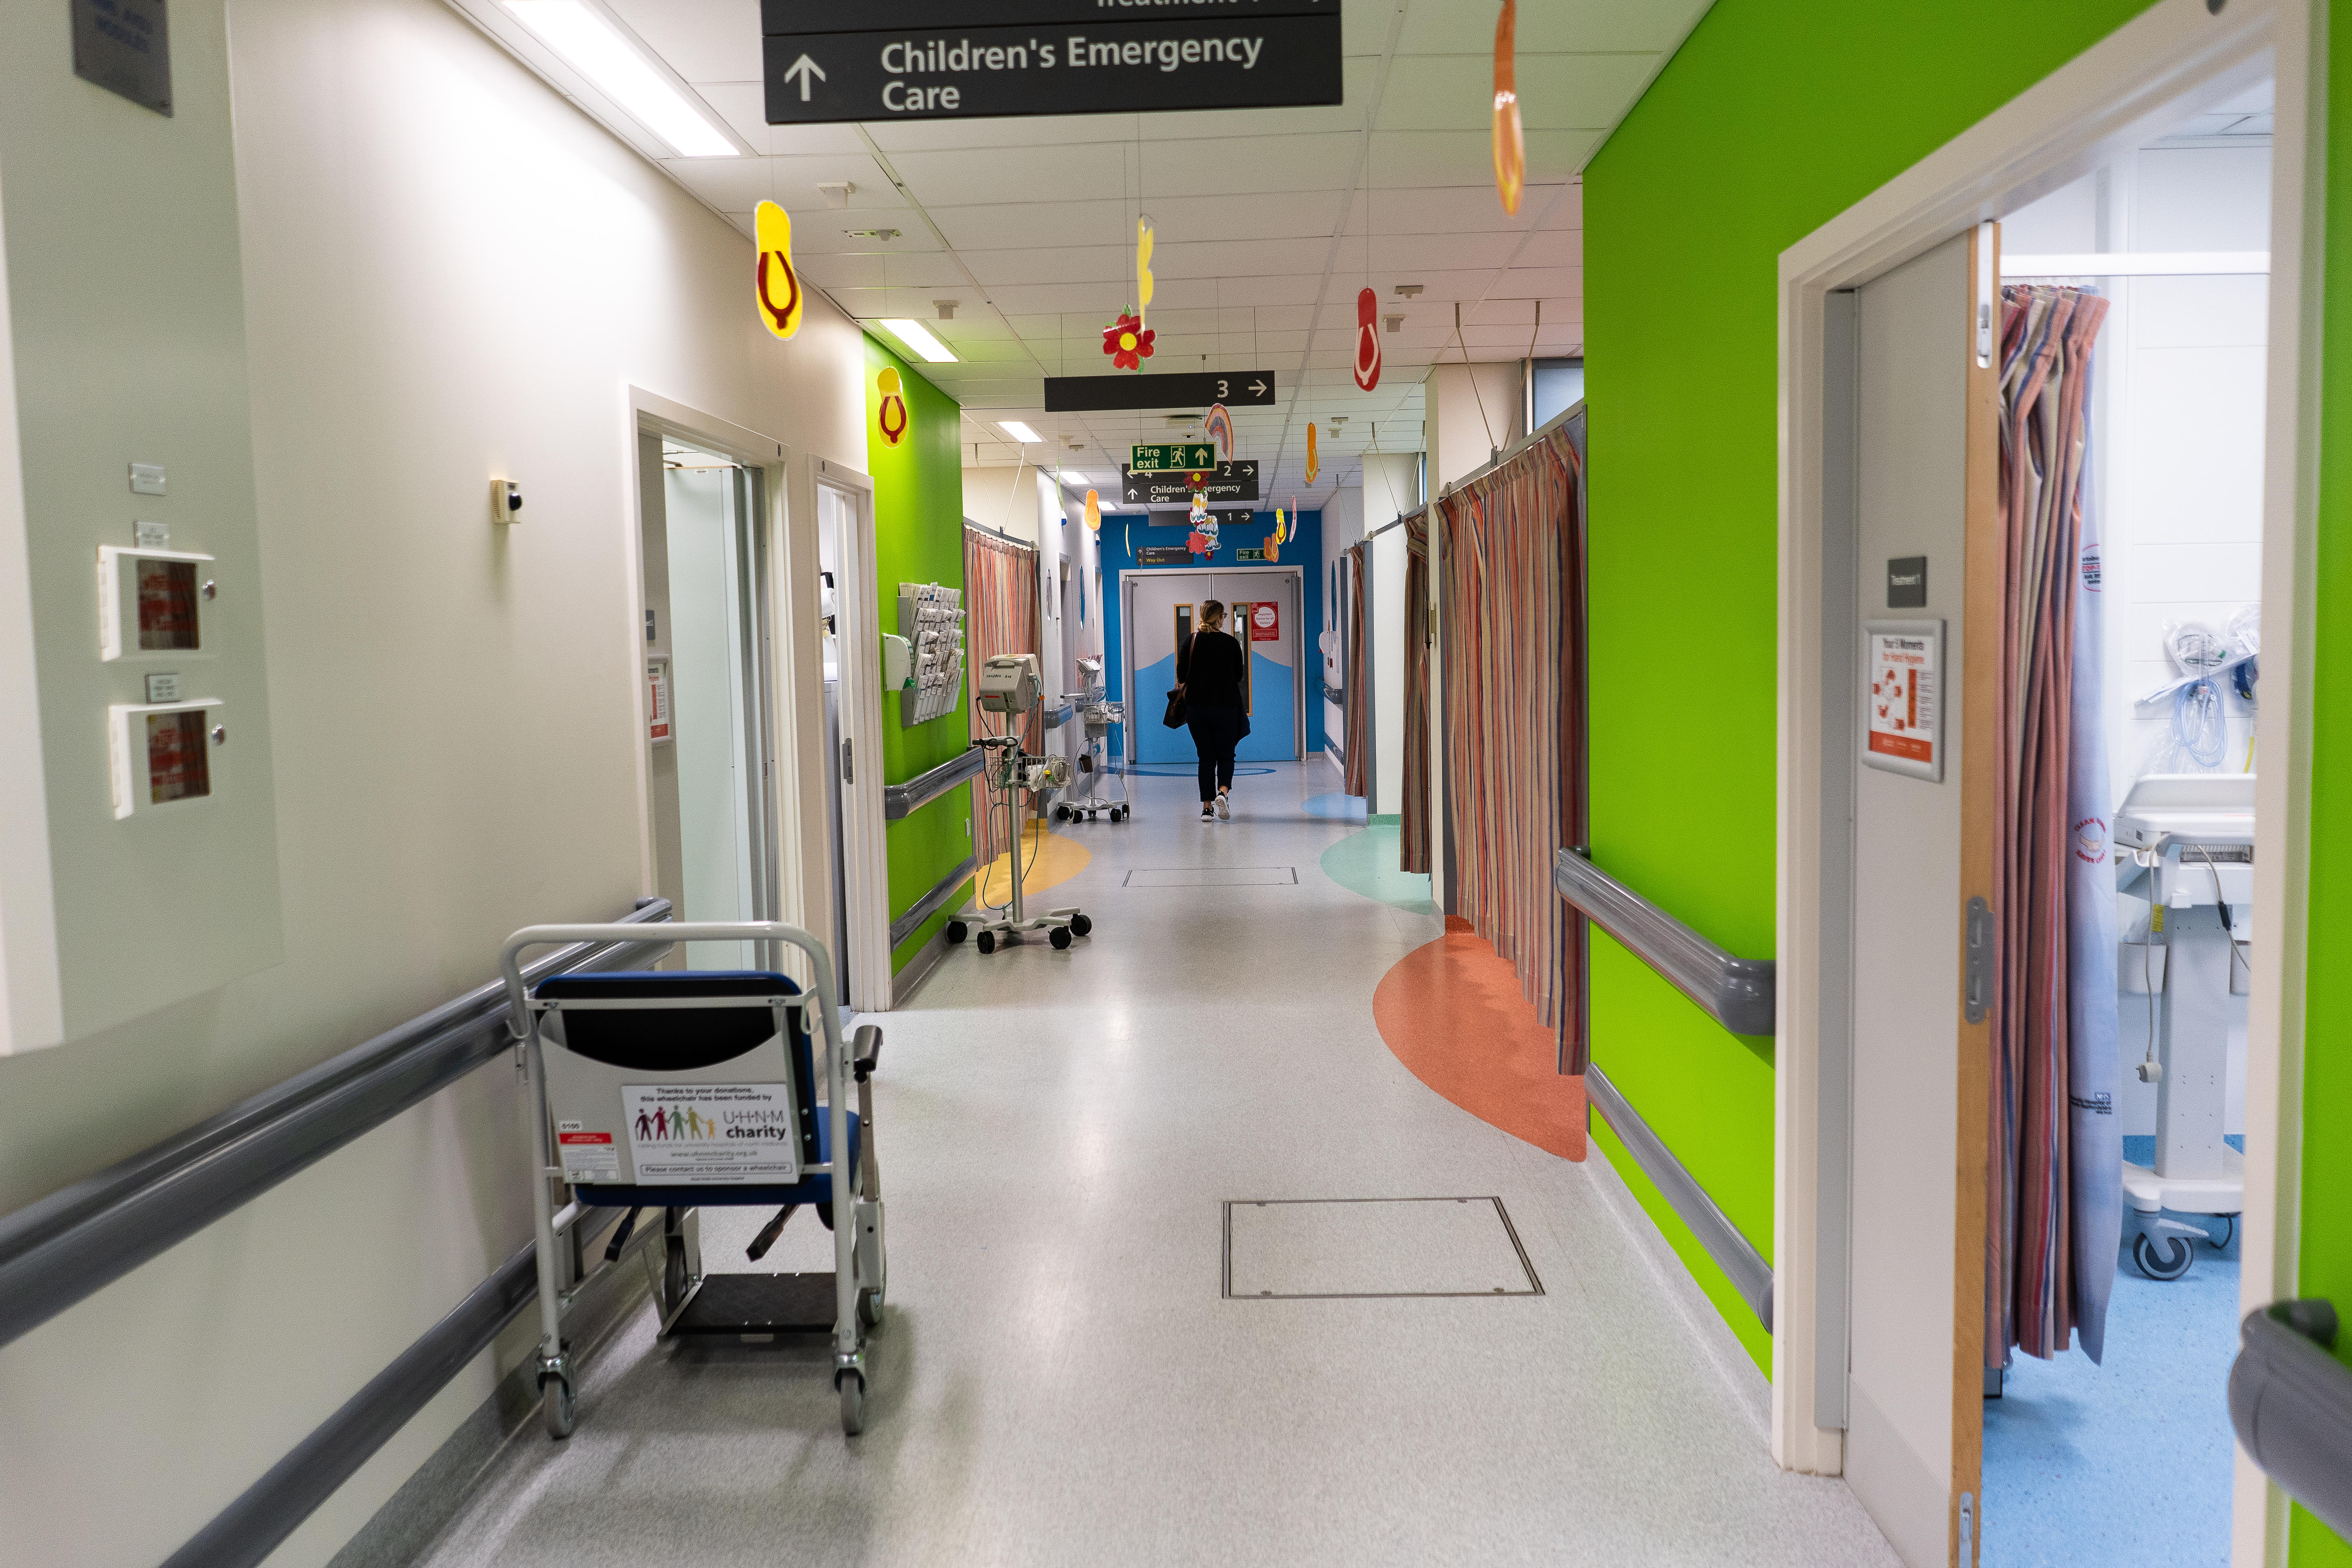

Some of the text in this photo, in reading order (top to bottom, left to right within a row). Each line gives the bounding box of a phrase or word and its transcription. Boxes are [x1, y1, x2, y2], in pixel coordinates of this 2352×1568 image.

[881, 36, 1264, 73] Children's Emergency
[881, 81, 961, 111] Care
[1217, 380, 1228, 398] 3
[1137, 447, 1160, 457] Fire
[1137, 459, 1159, 469] exit
[1224, 465, 1231, 476] 2
[1150, 485, 1241, 494] Children' ergency
[1227, 512, 1232, 521] 1
[726, 1125, 786, 1141] charity
